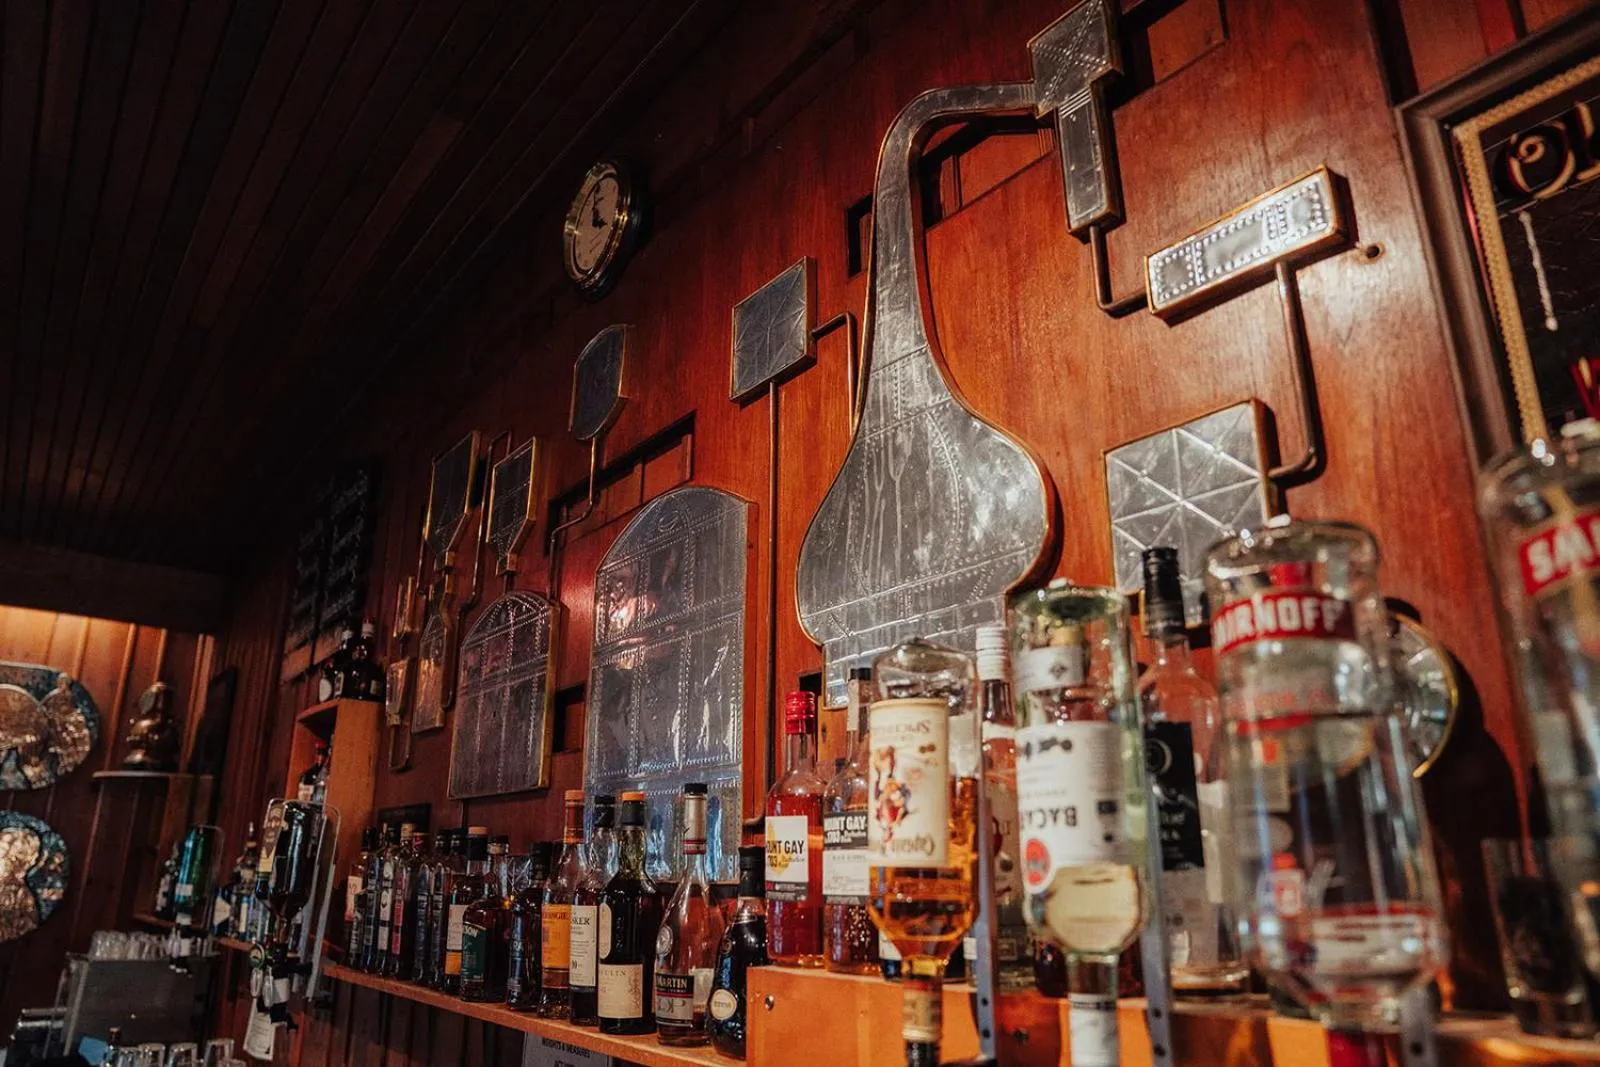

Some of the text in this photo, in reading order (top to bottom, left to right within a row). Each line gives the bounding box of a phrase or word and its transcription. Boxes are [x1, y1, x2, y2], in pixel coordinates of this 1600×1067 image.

[1213, 596, 1344, 650] MIRNOFF
[846, 816, 866, 830] GAY
[784, 840, 804, 854] GAY
